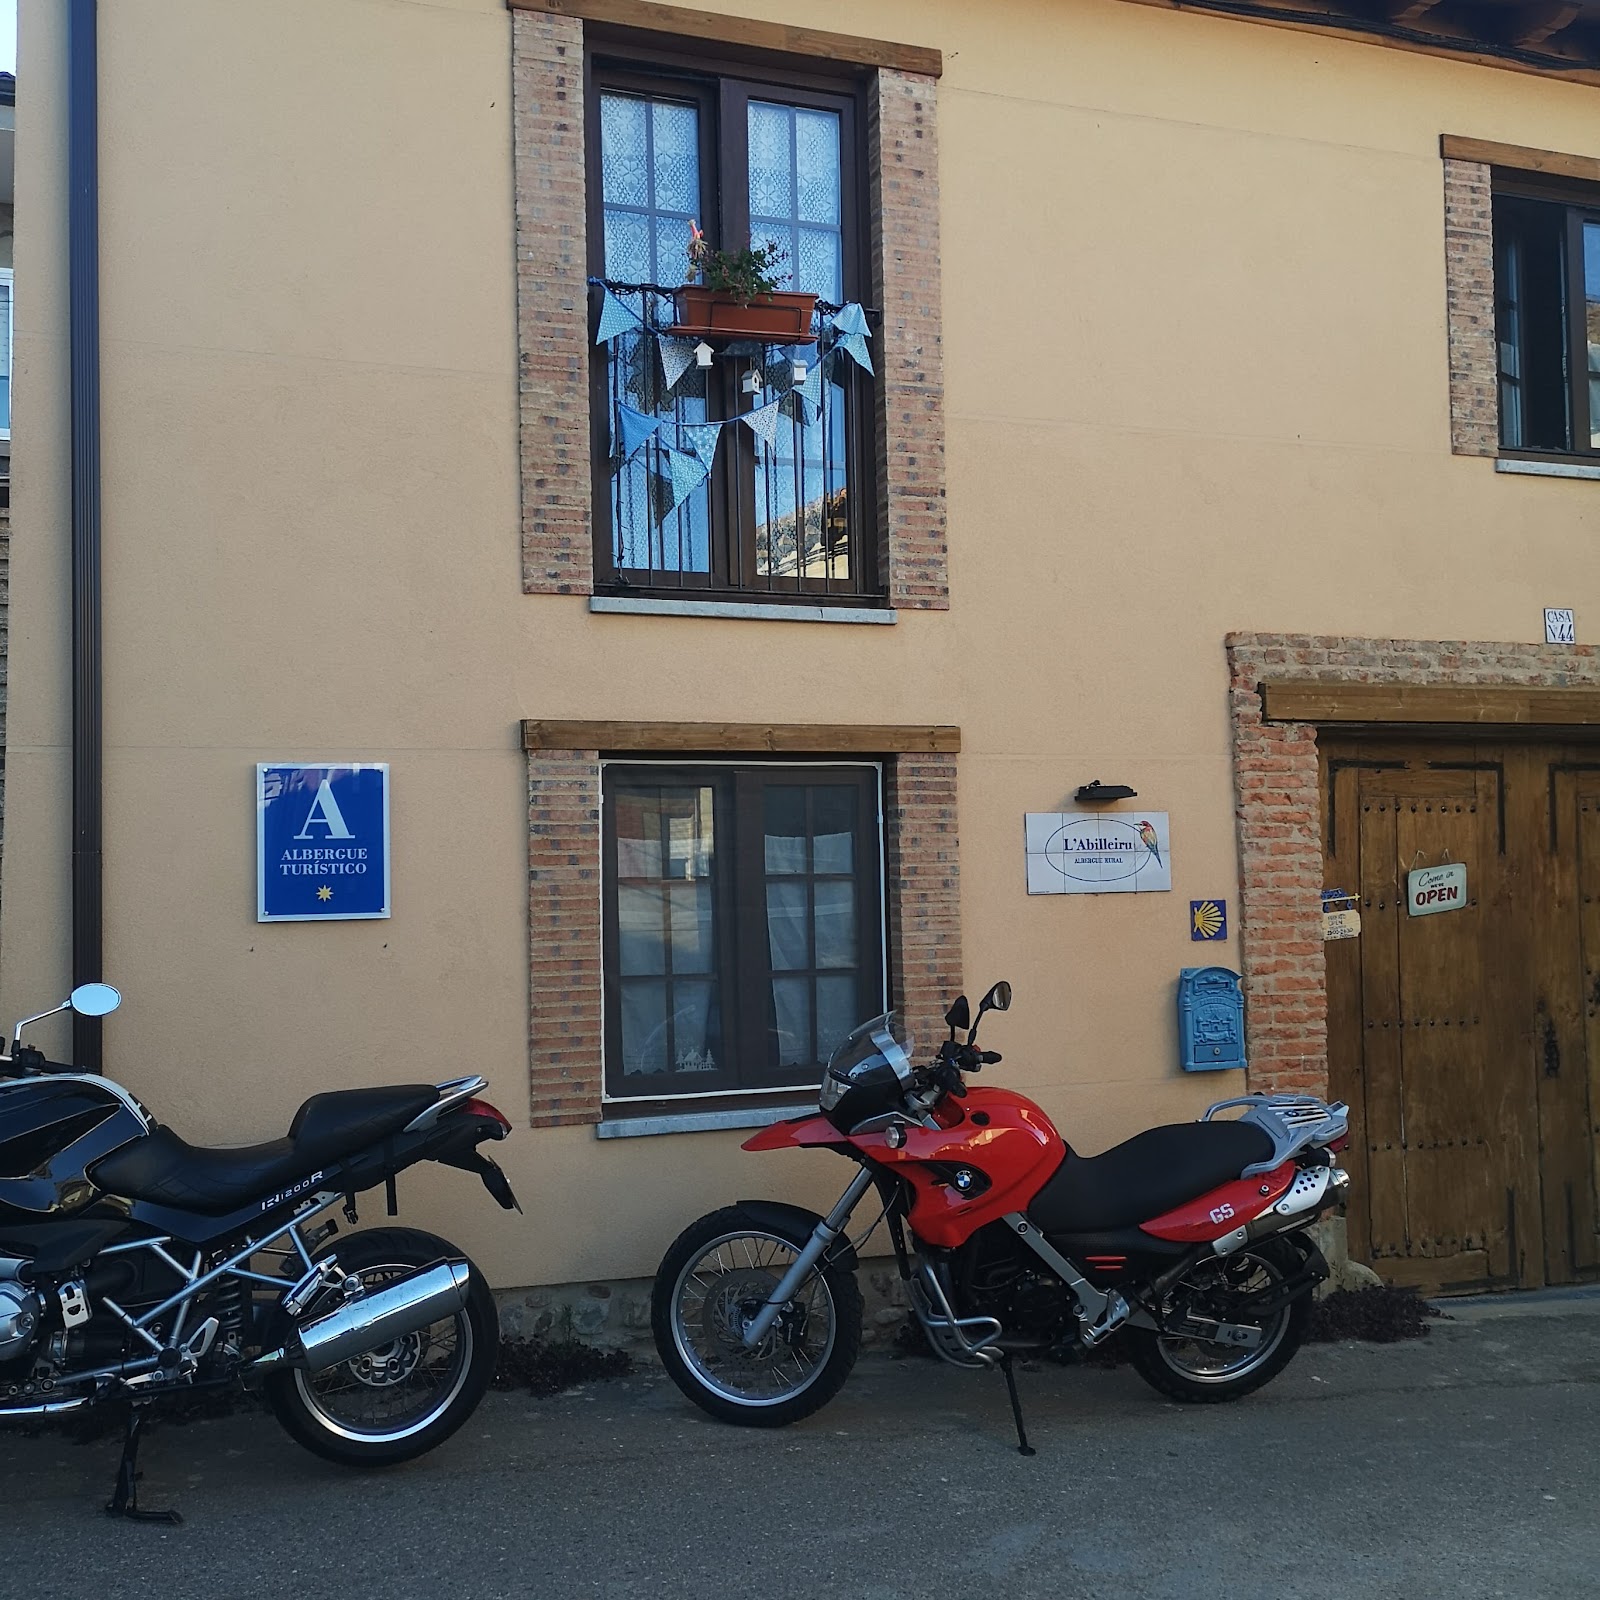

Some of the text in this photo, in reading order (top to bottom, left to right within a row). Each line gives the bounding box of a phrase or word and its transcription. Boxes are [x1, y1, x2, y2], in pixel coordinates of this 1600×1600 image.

[1547, 611, 1571, 623] CASA
[293, 779, 356, 840] A
[1063, 837, 1133, 851] L'Abilleiru
[281, 848, 368, 861] ALBERGUE
[280, 860, 367, 876] TURÍSTICO
[1418, 871, 1444, 887] Come
[1415, 885, 1458, 906] OPEN
[1209, 1203, 1235, 1225] GS
